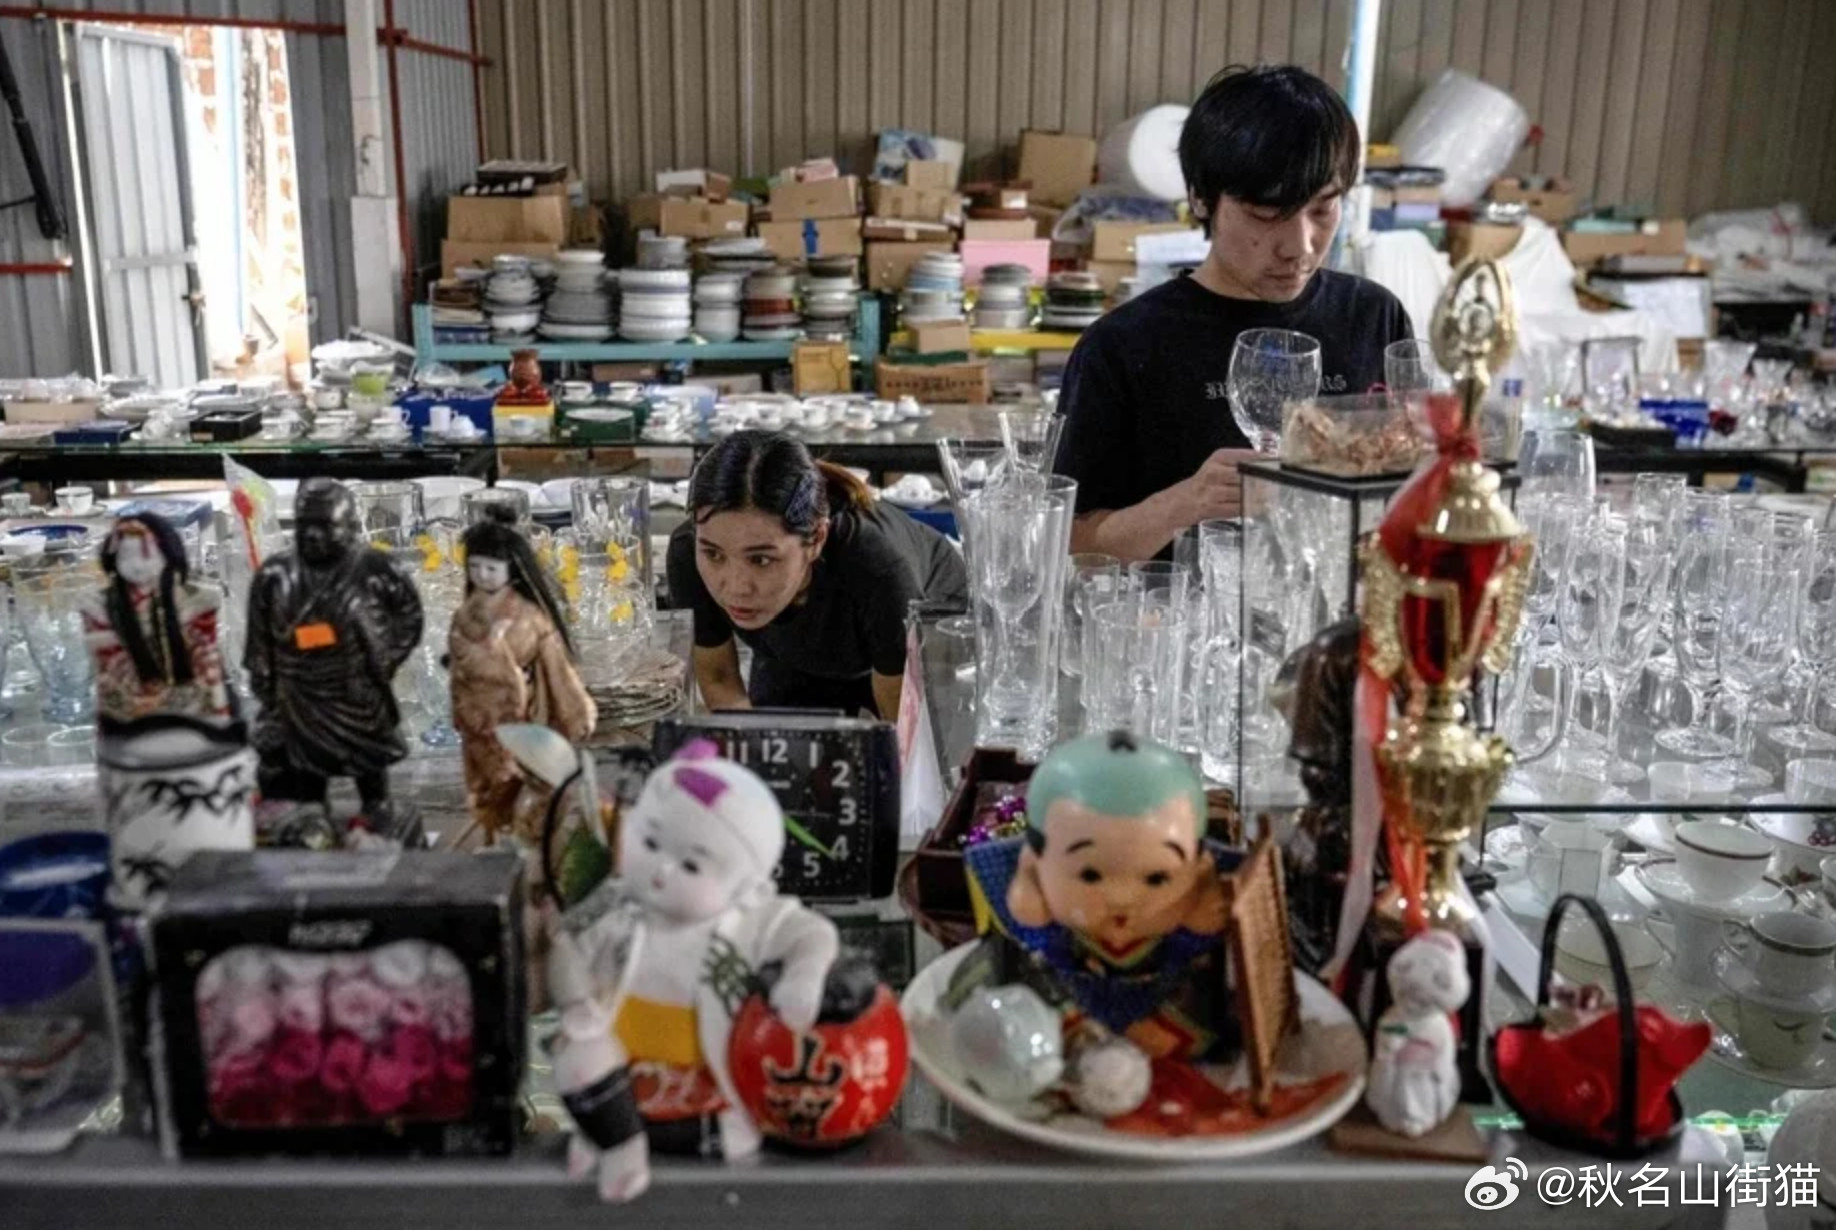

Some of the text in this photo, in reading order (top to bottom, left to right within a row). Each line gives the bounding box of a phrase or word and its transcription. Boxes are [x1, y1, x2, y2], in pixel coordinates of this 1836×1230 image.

[762, 738, 788, 763] 12
[809, 741, 818, 768] 1
[831, 761, 850, 787] 2
[838, 798, 857, 825] 3
[830, 835, 849, 861] 4
[803, 852, 821, 878] 5
